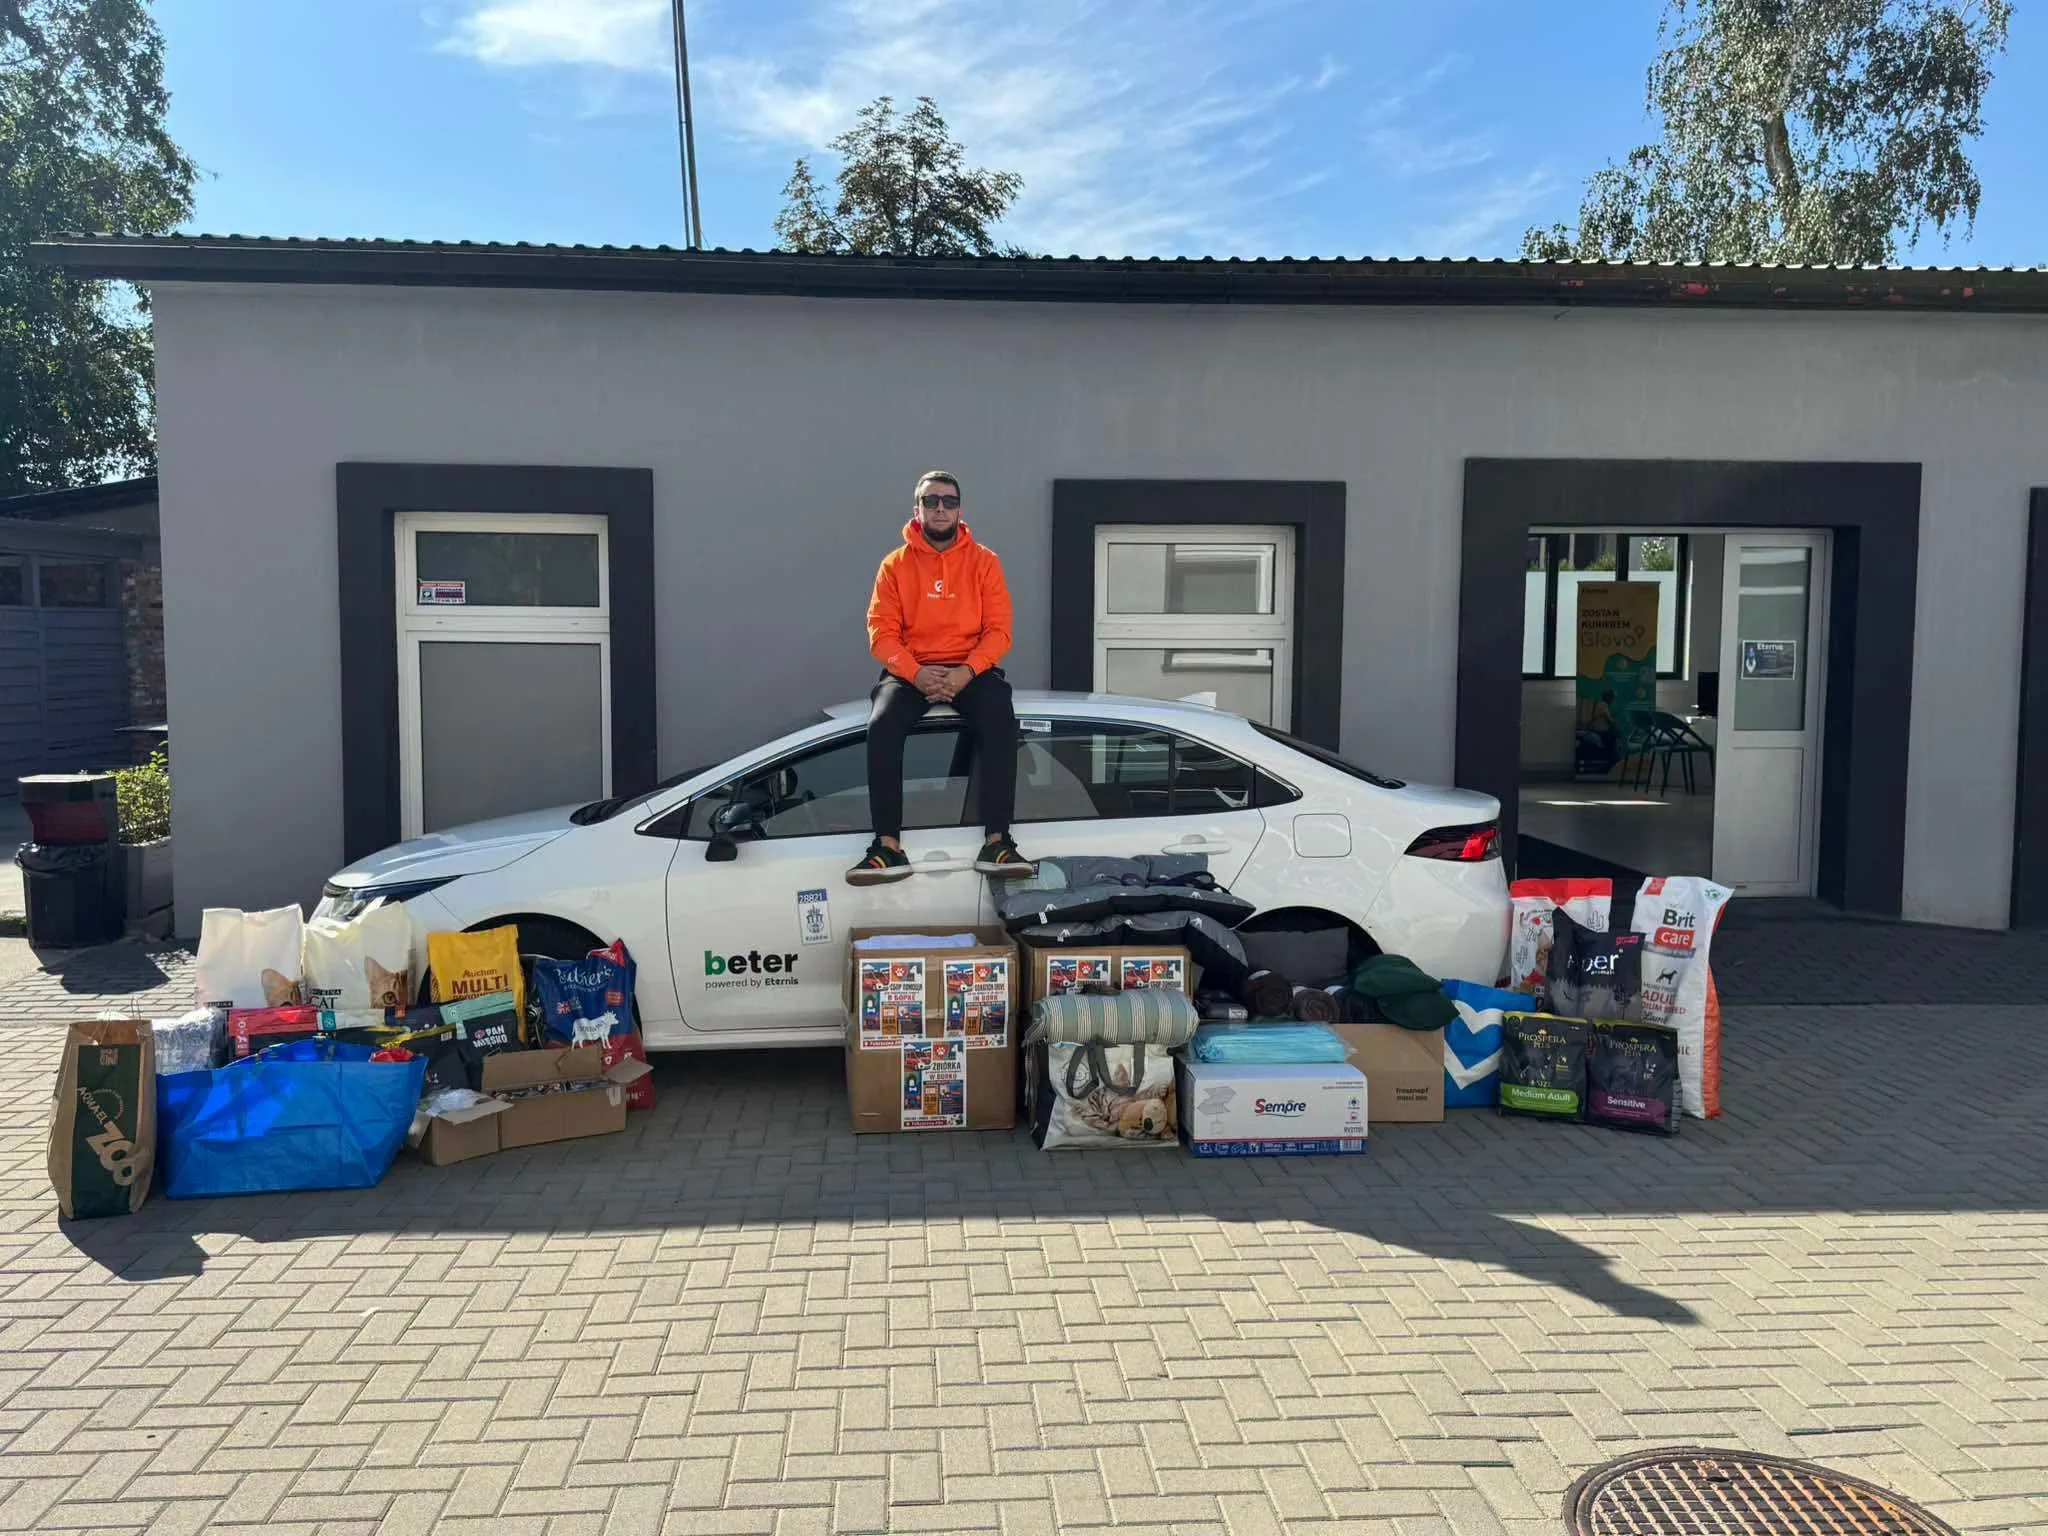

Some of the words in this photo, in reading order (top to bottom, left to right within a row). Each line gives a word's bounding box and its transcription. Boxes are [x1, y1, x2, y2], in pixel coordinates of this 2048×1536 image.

[1663, 909, 1696, 928] Brit
[704, 950, 799, 976] beter
[463, 968, 497, 978] Auchan
[705, 978, 748, 991] powered
[750, 977, 762, 989] by
[764, 976, 799, 986] Eternis
[485, 1024, 505, 1037] PAN
[1518, 1032, 1567, 1045] PROSPERA
[1609, 1039, 1657, 1053] PROSPERA
[1511, 1087, 1546, 1100] Medium
[1254, 1098, 1307, 1114] Sempre
[1607, 1096, 1646, 1109] Sensitive
